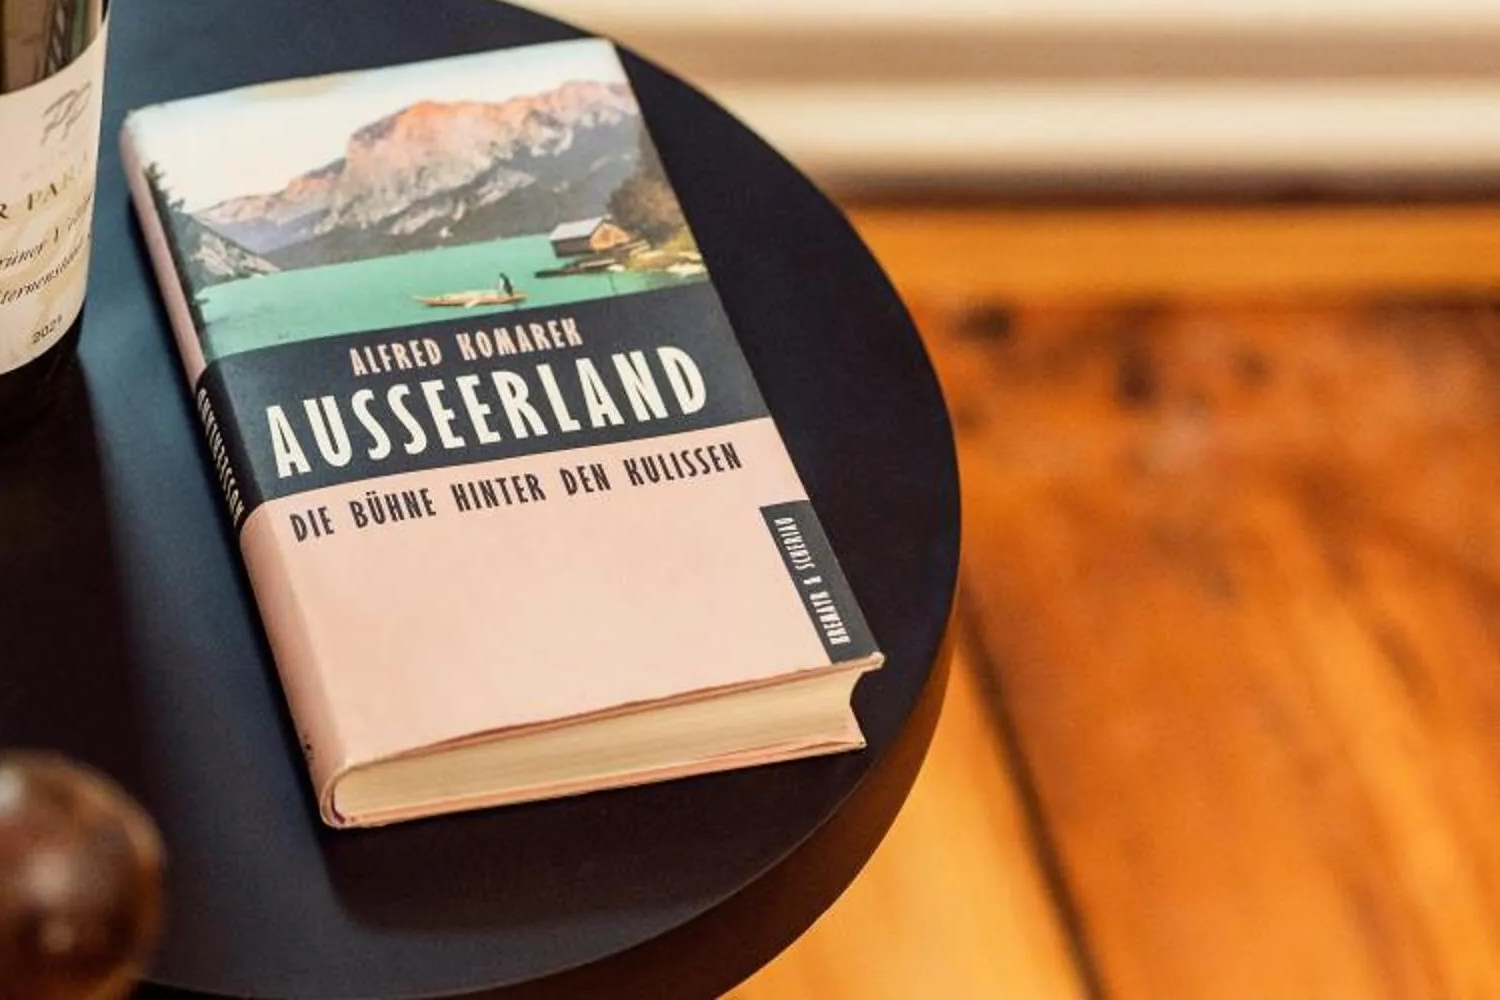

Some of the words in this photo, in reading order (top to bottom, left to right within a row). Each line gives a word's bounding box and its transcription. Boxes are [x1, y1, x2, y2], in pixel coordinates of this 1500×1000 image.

[349, 338, 442, 377] ALFRED
[455, 317, 584, 361] KOMAREK
[265, 346, 708, 479] AUSSEERLAND
[289, 506, 335, 543] DIE
[348, 488, 437, 529] BÜHNE
[450, 473, 546, 512] HINTER
[559, 463, 612, 496] DEN
[622, 442, 743, 487] KULISSEN
